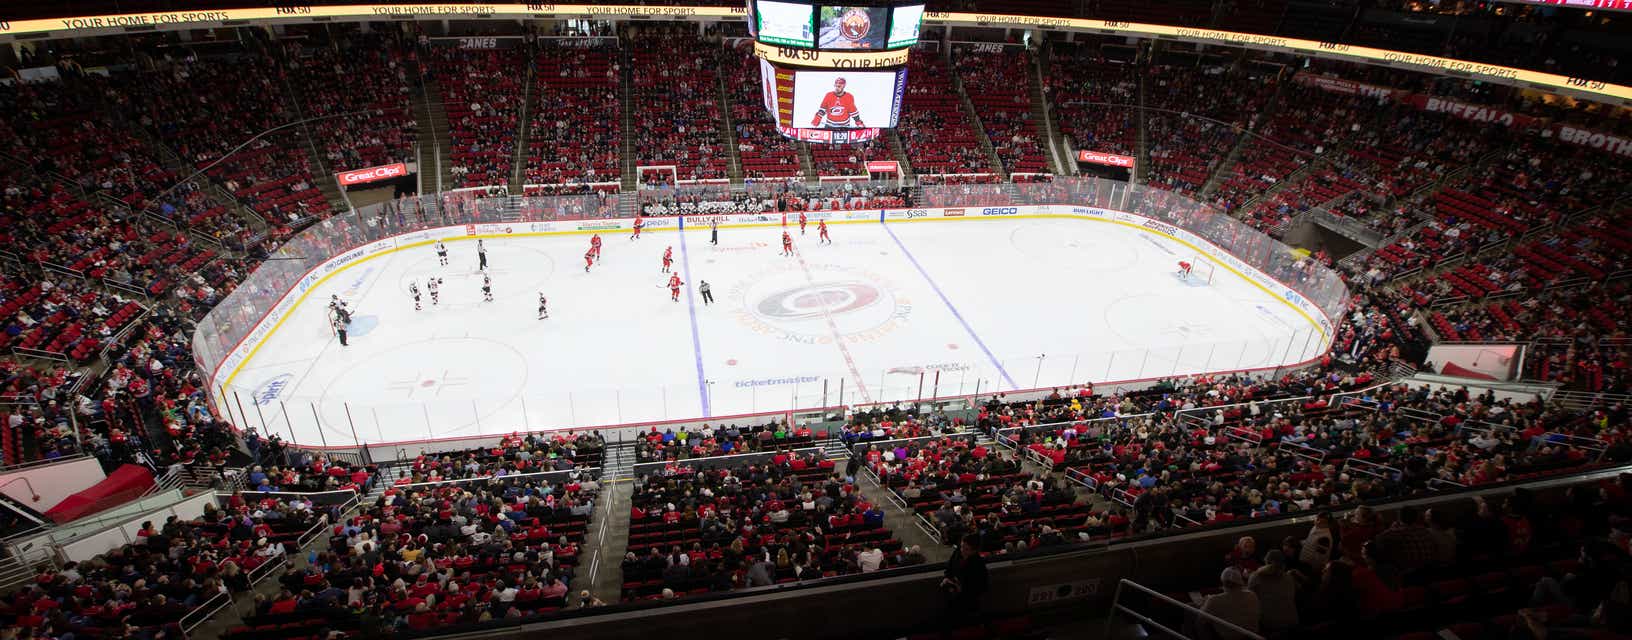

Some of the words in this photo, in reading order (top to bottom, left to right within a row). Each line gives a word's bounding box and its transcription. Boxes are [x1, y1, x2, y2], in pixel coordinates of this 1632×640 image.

[276, 7, 296, 15] FOX
[372, 7, 401, 15] YOUR
[404, 6, 434, 14] HOME
[438, 6, 457, 14] FOR
[460, 6, 495, 14] SPORTS
[587, 7, 611, 15] YOUR
[614, 7, 640, 15] HOME
[644, 7, 660, 15] FOR
[663, 7, 696, 15] SPORTS
[62, 18, 103, 29] YOUR
[107, 15, 149, 26] HOME
[153, 13, 179, 24] FOR
[182, 12, 229, 22] SPORTS
[976, 15, 997, 23] YOUR
[999, 16, 1021, 24] HOME
[1024, 17, 1040, 25] FOR
[1042, 18, 1071, 26] SPORTS
[1176, 28, 1201, 38] YOUR
[1203, 31, 1228, 41] HOME
[1232, 33, 1251, 42] FOR
[1252, 35, 1287, 46] SPORTS
[459, 38, 496, 48] CANES
[1319, 41, 1338, 50] FOX
[778, 47, 800, 59] FOX
[802, 50, 819, 61] 50
[832, 58, 871, 68] YOUR
[1383, 52, 1412, 64] YOUR
[1415, 56, 1446, 68] HOME
[1450, 61, 1473, 72] FOR
[1475, 64, 1517, 79] SPORTS
[1566, 77, 1590, 88] FOX
[1425, 98, 1514, 126] BUFFALO
[1084, 153, 1107, 161] Great
[1107, 156, 1128, 165] Clips
[345, 171, 375, 181] Great
[375, 166, 399, 176] Clips
[983, 207, 1017, 215] GEICO
[646, 219, 669, 229] pepsi
[736, 376, 820, 388] ticketmaster
